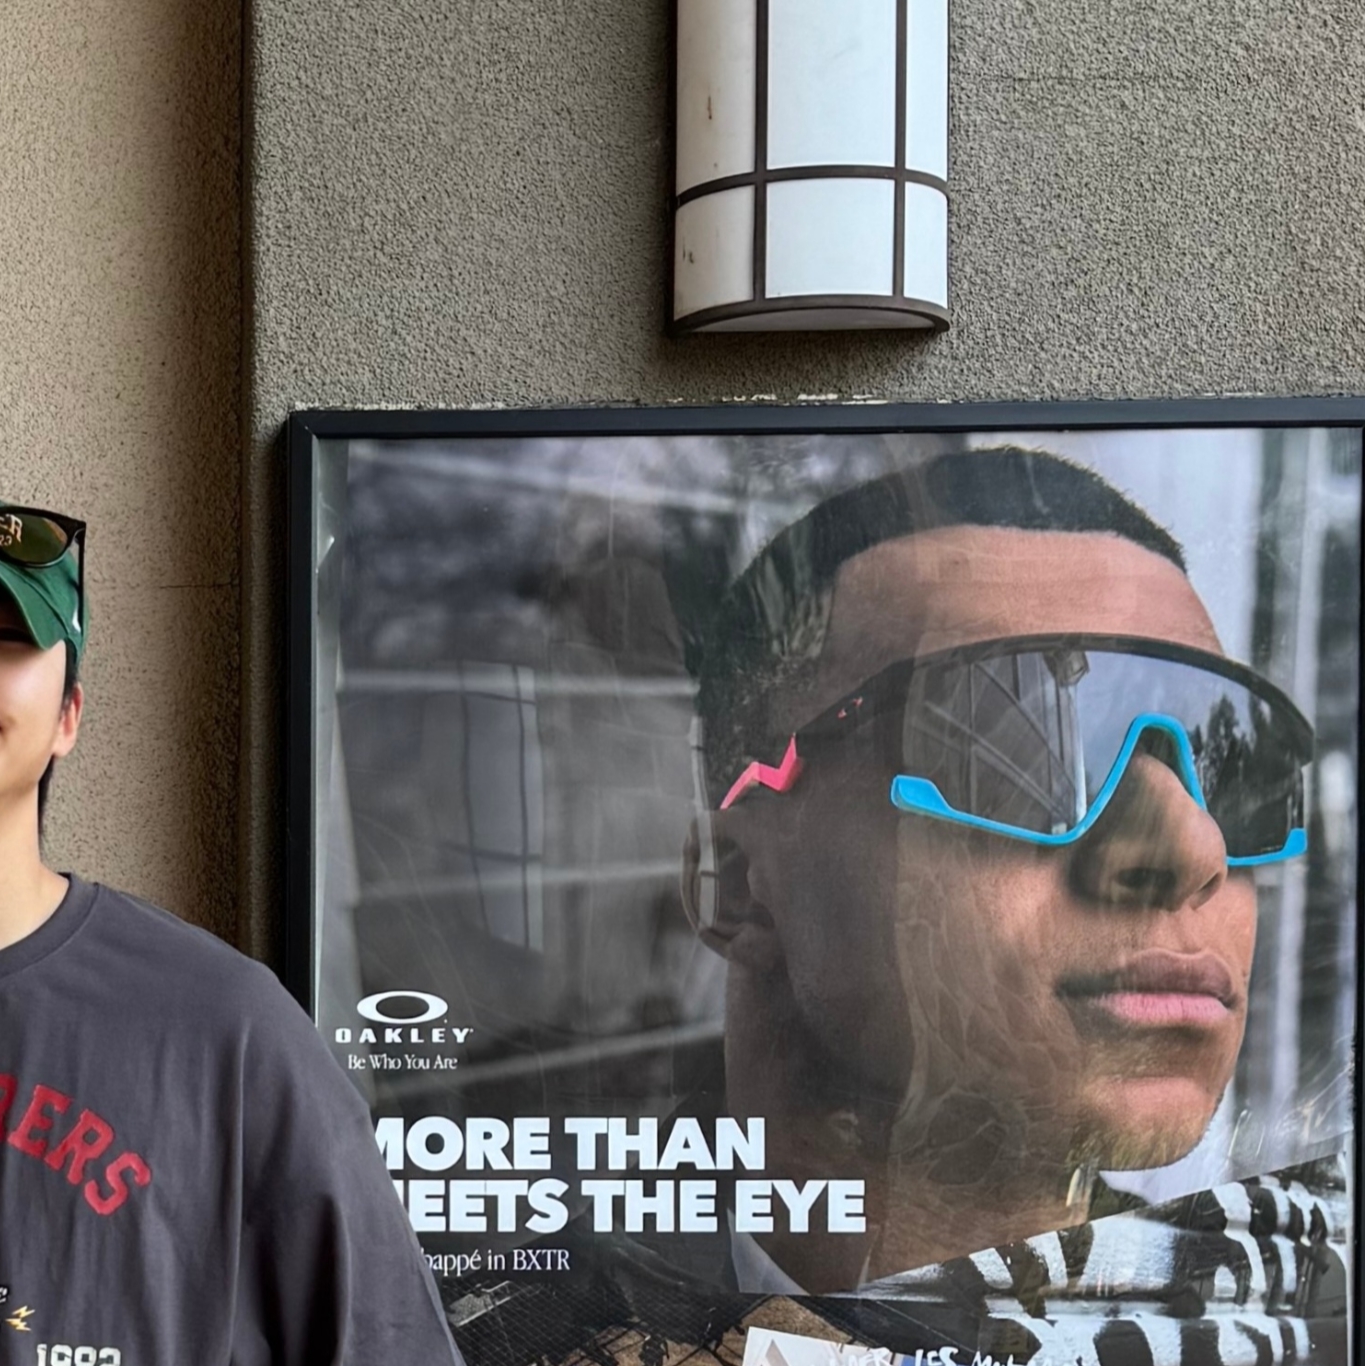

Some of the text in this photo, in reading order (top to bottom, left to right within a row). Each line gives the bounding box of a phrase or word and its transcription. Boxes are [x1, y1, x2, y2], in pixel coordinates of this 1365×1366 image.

[335, 1028, 472, 1043] OAKLEY
[348, 1054, 458, 1070] Be Who You Are
[565, 1117, 765, 1170] THAN
[393, 1178, 866, 1234] EETS THE EYE
[487, 1248, 506, 1271] in
[513, 1249, 571, 1271] BXTR
